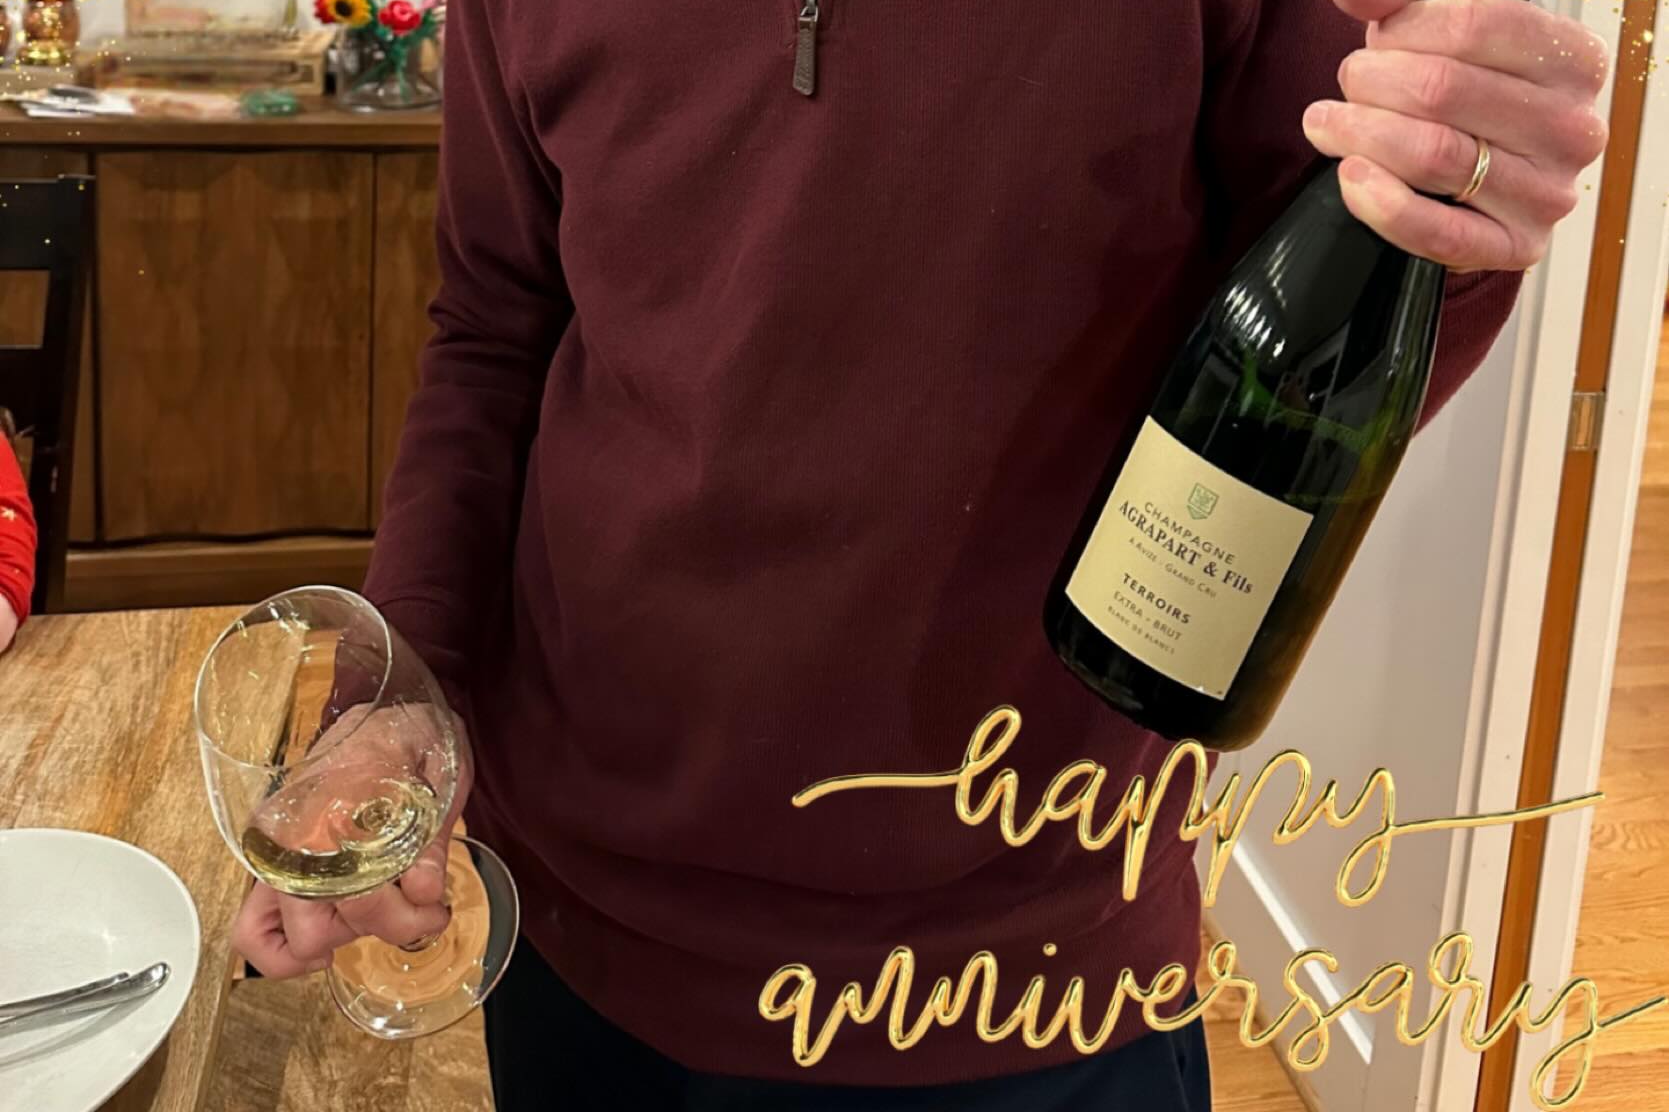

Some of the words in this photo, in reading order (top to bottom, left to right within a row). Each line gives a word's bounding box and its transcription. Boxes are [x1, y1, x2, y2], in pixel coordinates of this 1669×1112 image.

[1119, 500, 1202, 566] AGRAPART
[1203, 561, 1218, 577] &
[1222, 570, 1254, 594] Fils
[1144, 502, 1236, 565] CHAMPAGNE
[1114, 591, 1143, 617] EXTRA
[1153, 619, 1183, 640] BRUT
[1123, 573, 1191, 624] TERROIRS
